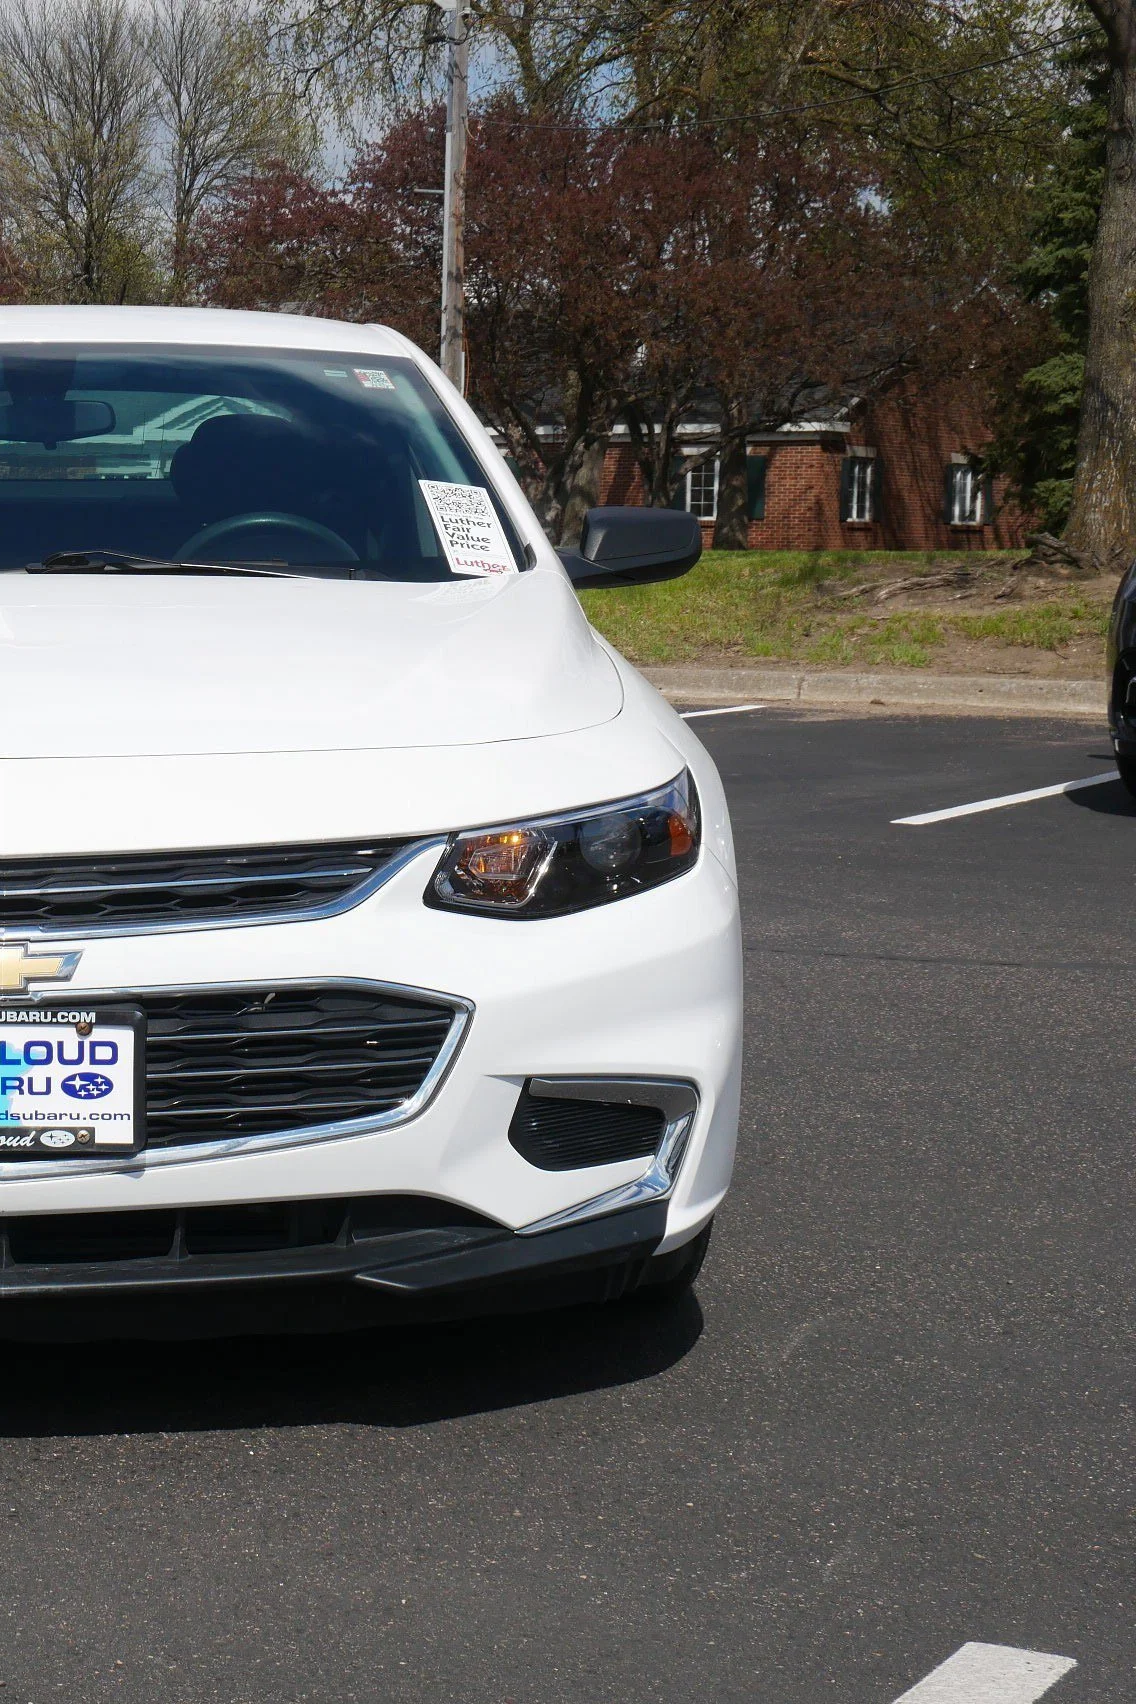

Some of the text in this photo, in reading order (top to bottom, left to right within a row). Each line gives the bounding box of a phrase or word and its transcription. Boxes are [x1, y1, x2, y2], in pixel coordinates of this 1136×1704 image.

[440, 515, 492, 529] Luther
[443, 523, 472, 533] Fair
[445, 531, 491, 544] Value
[449, 540, 490, 551] Price
[455, 557, 509, 572] Luther
